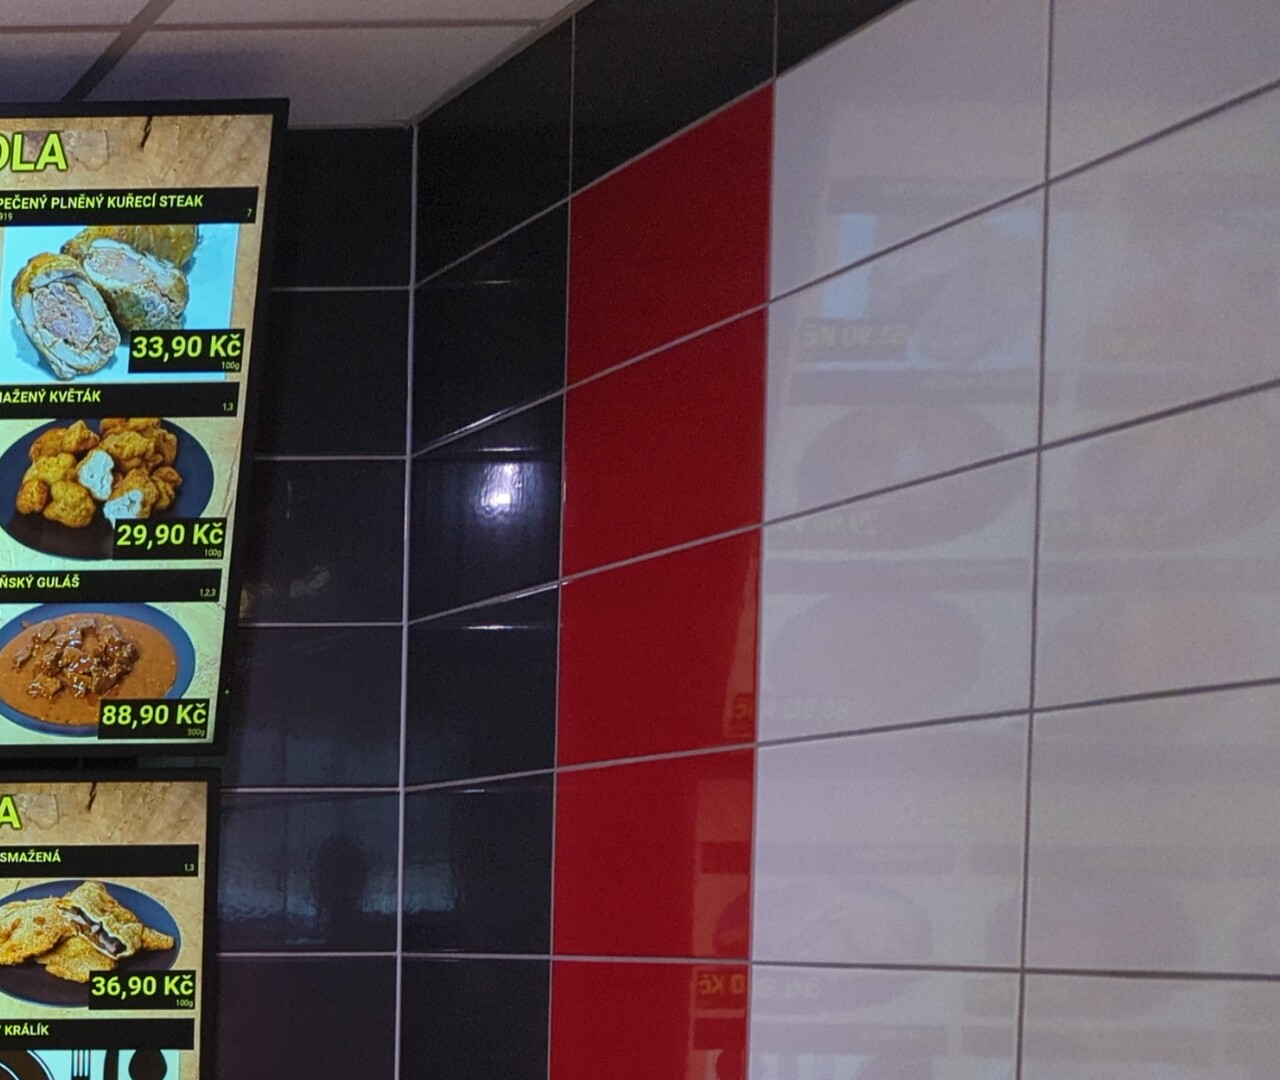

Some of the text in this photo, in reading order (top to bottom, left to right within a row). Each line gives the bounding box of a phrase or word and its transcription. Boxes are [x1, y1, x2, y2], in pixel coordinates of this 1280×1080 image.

[49, 192, 106, 211] PLNĚNÝ
[106, 191, 158, 210] KUŘECÍ
[157, 193, 205, 209] STEAK
[131, 332, 242, 363] 33,90 Kč
[48, 386, 102, 404] KVĚTÁK
[3, 1021, 50, 1037] KRÁLÍK
